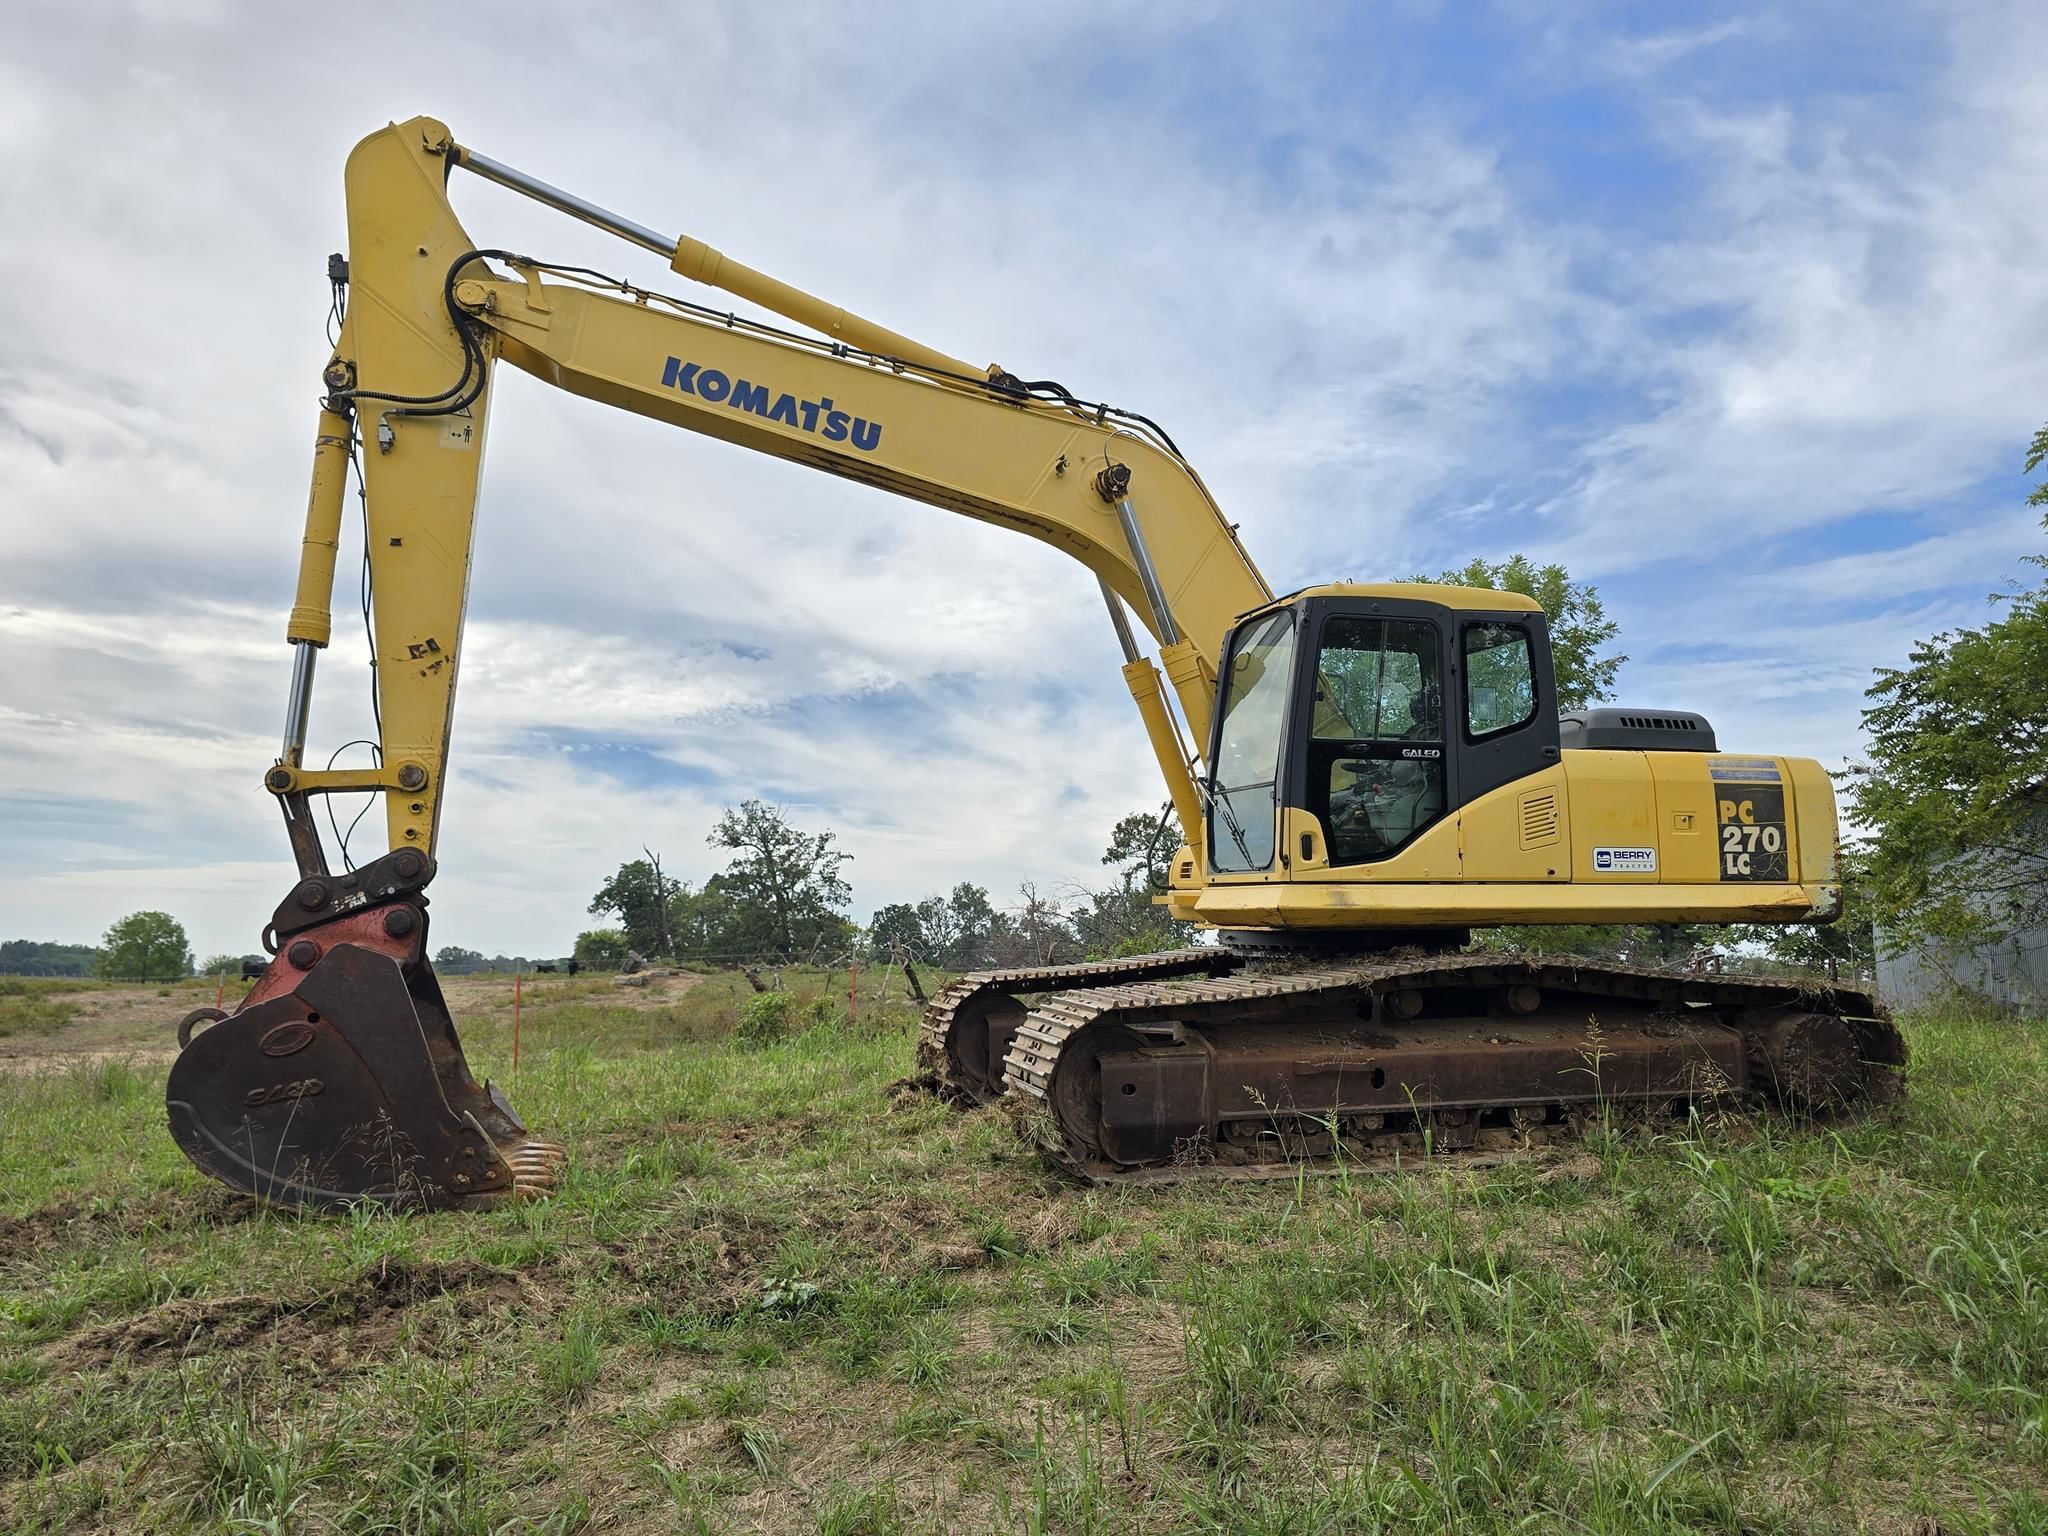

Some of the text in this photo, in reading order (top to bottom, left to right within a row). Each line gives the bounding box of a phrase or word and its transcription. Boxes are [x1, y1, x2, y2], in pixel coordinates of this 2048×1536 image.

[661, 356, 882, 451] KOMATSU
[1402, 749, 1440, 758] GALEO
[1719, 800, 1754, 825] PC
[1722, 826, 1781, 853] 270
[1613, 851, 1652, 859] BERRY
[1725, 853, 1751, 875] LC
